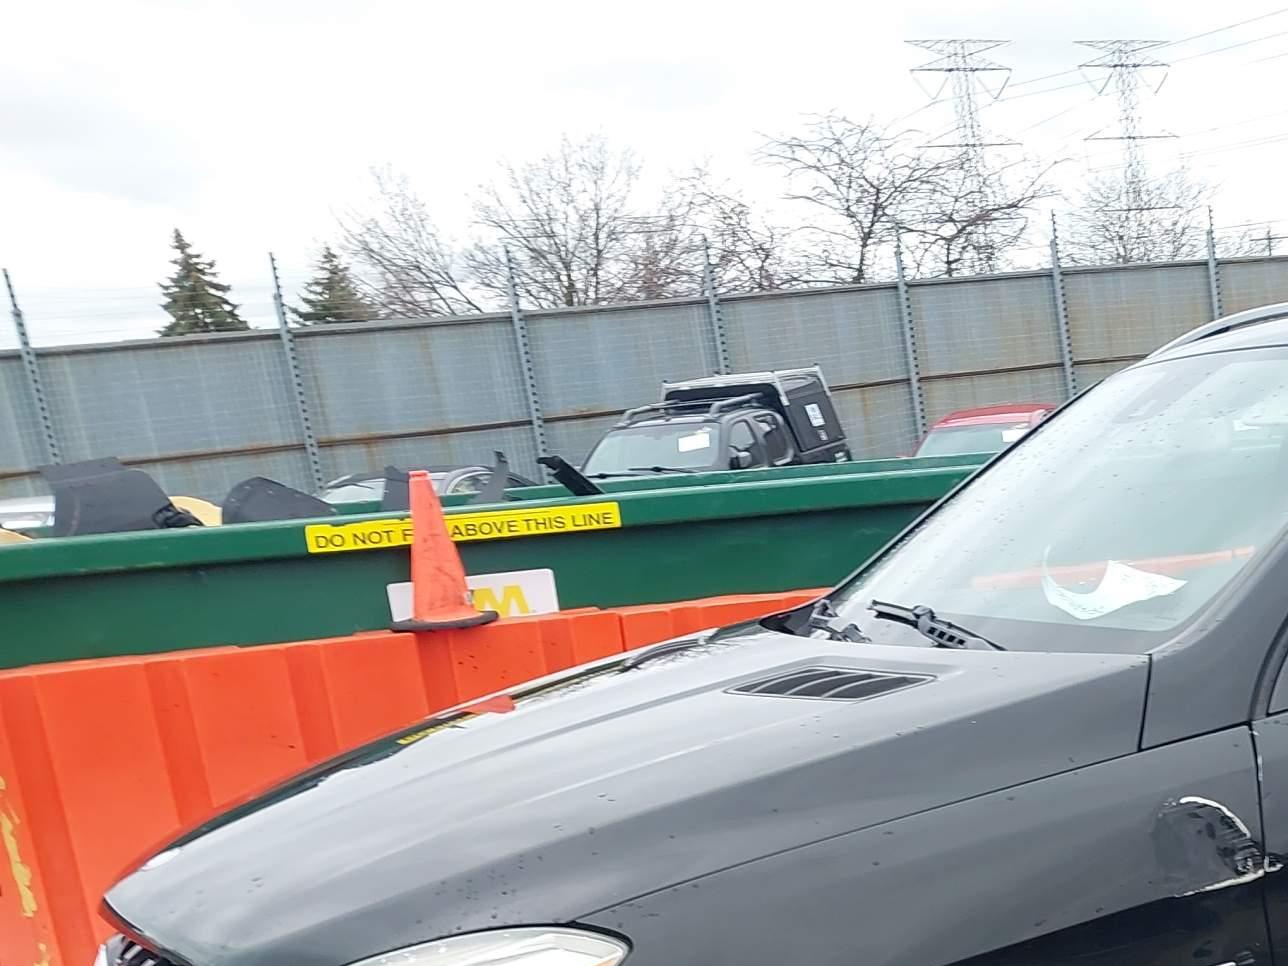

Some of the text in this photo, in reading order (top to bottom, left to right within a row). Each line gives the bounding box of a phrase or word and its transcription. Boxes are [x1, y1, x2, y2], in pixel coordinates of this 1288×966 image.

[315, 534, 345, 548] DO
[352, 530, 394, 546] NOT
[451, 520, 519, 538] ABOVE
[524, 515, 566, 532] THIS
[571, 511, 614, 528] LINE
